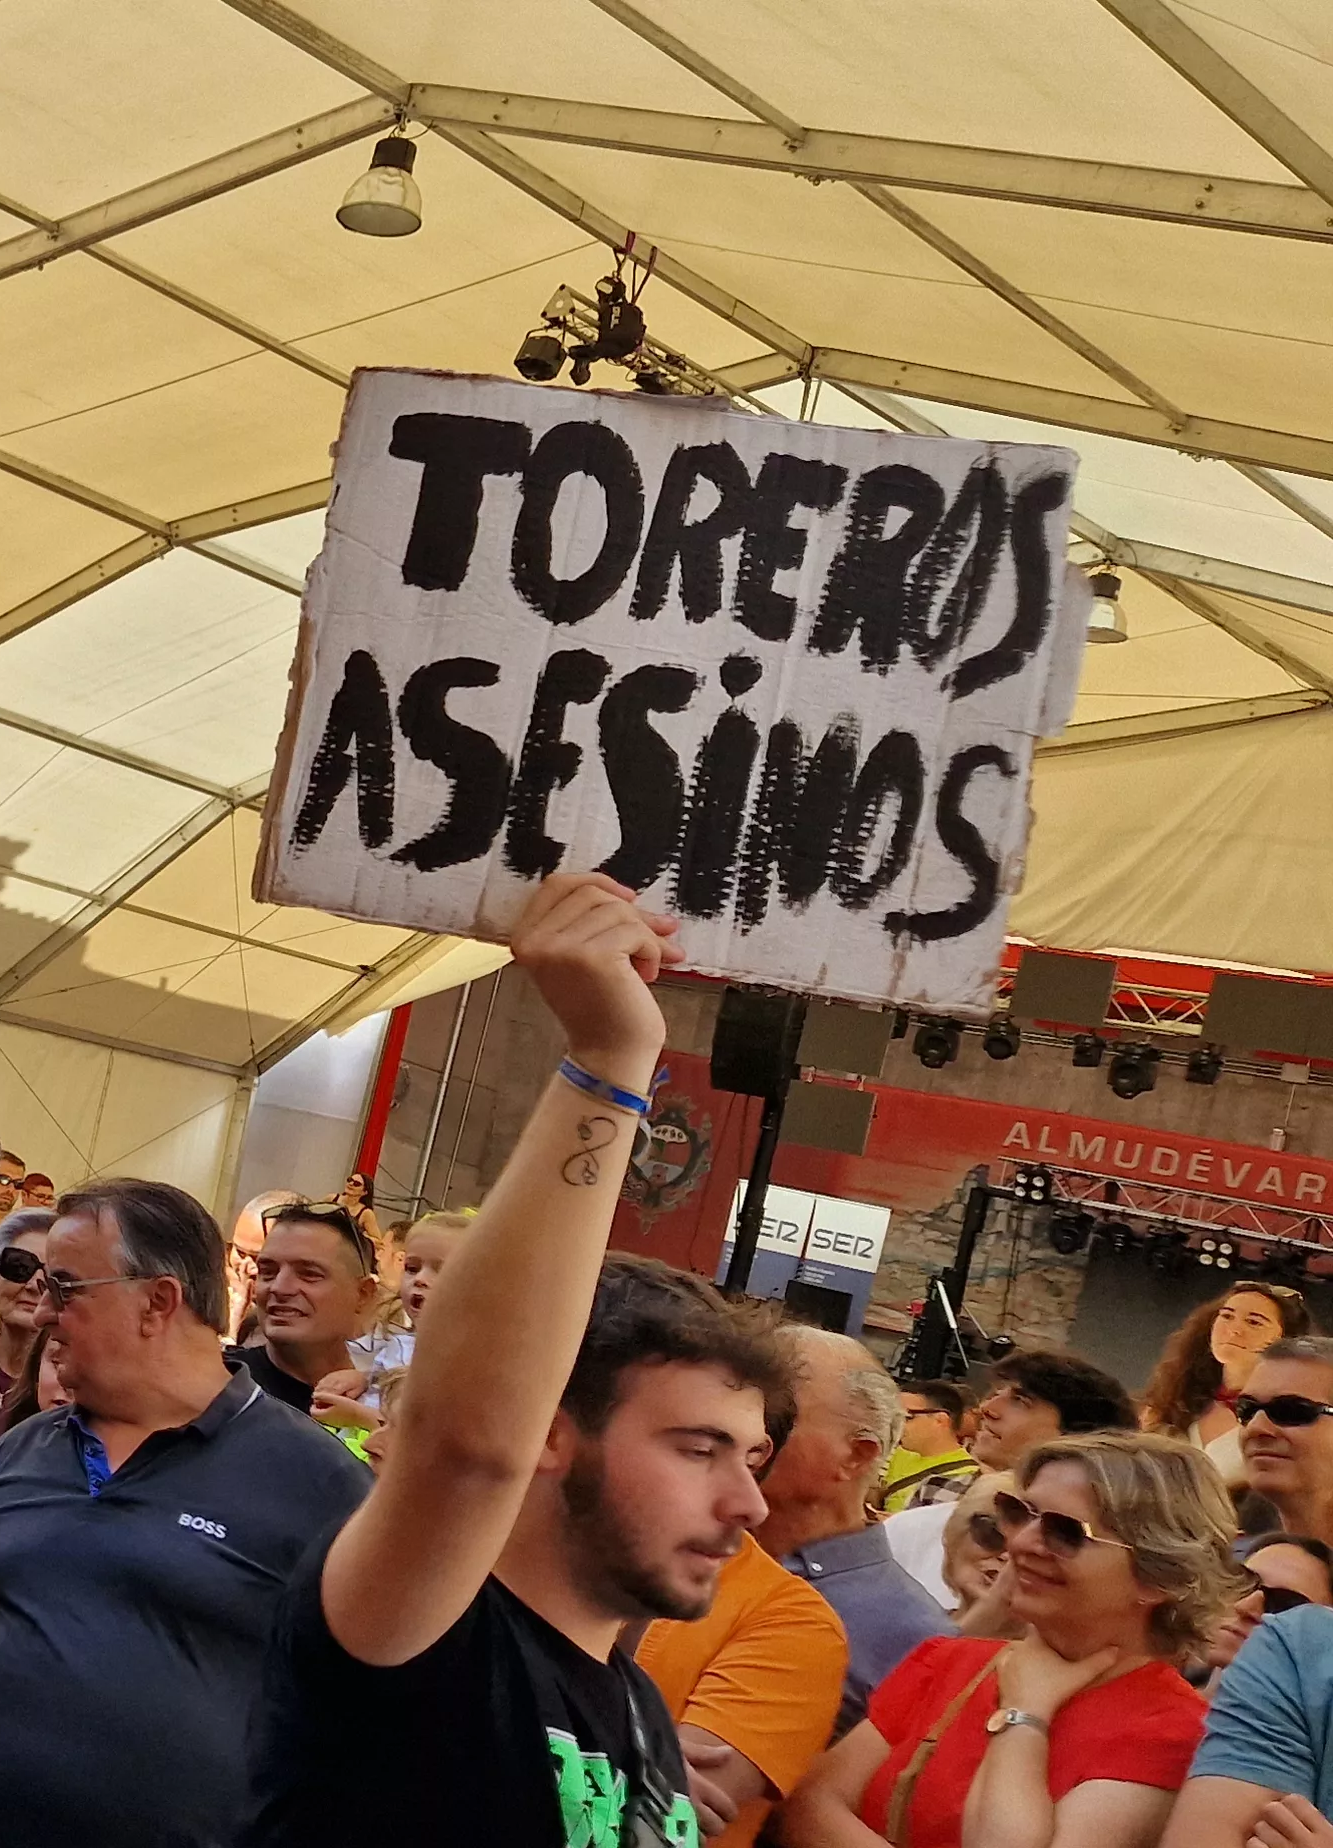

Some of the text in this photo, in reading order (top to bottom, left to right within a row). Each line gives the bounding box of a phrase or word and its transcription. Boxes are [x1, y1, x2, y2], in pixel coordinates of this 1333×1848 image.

[389, 412, 1071, 703] TOREROS
[1002, 1120, 1327, 1204] ALMUDÉVAR
[758, 1216, 800, 1244] ER
[811, 1228, 875, 1259] SER
[178, 1513, 227, 1539] BOSS
